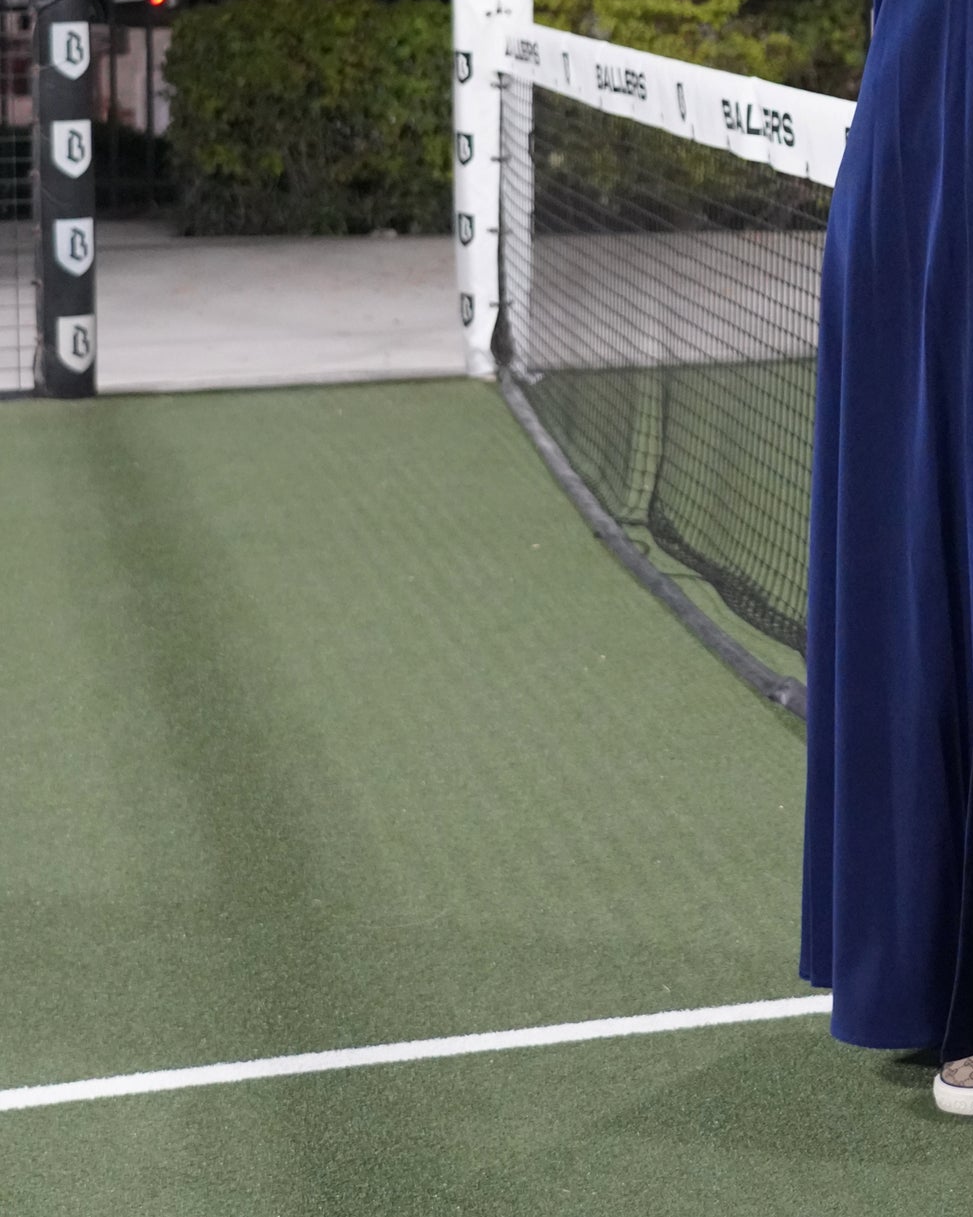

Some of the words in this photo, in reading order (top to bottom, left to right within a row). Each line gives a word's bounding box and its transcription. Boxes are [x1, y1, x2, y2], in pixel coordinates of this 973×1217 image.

[66, 31, 84, 65] B
[596, 64, 647, 100] BALLERS
[67, 130, 85, 163] B
[69, 228, 88, 261] B
[71, 325, 91, 359] B
